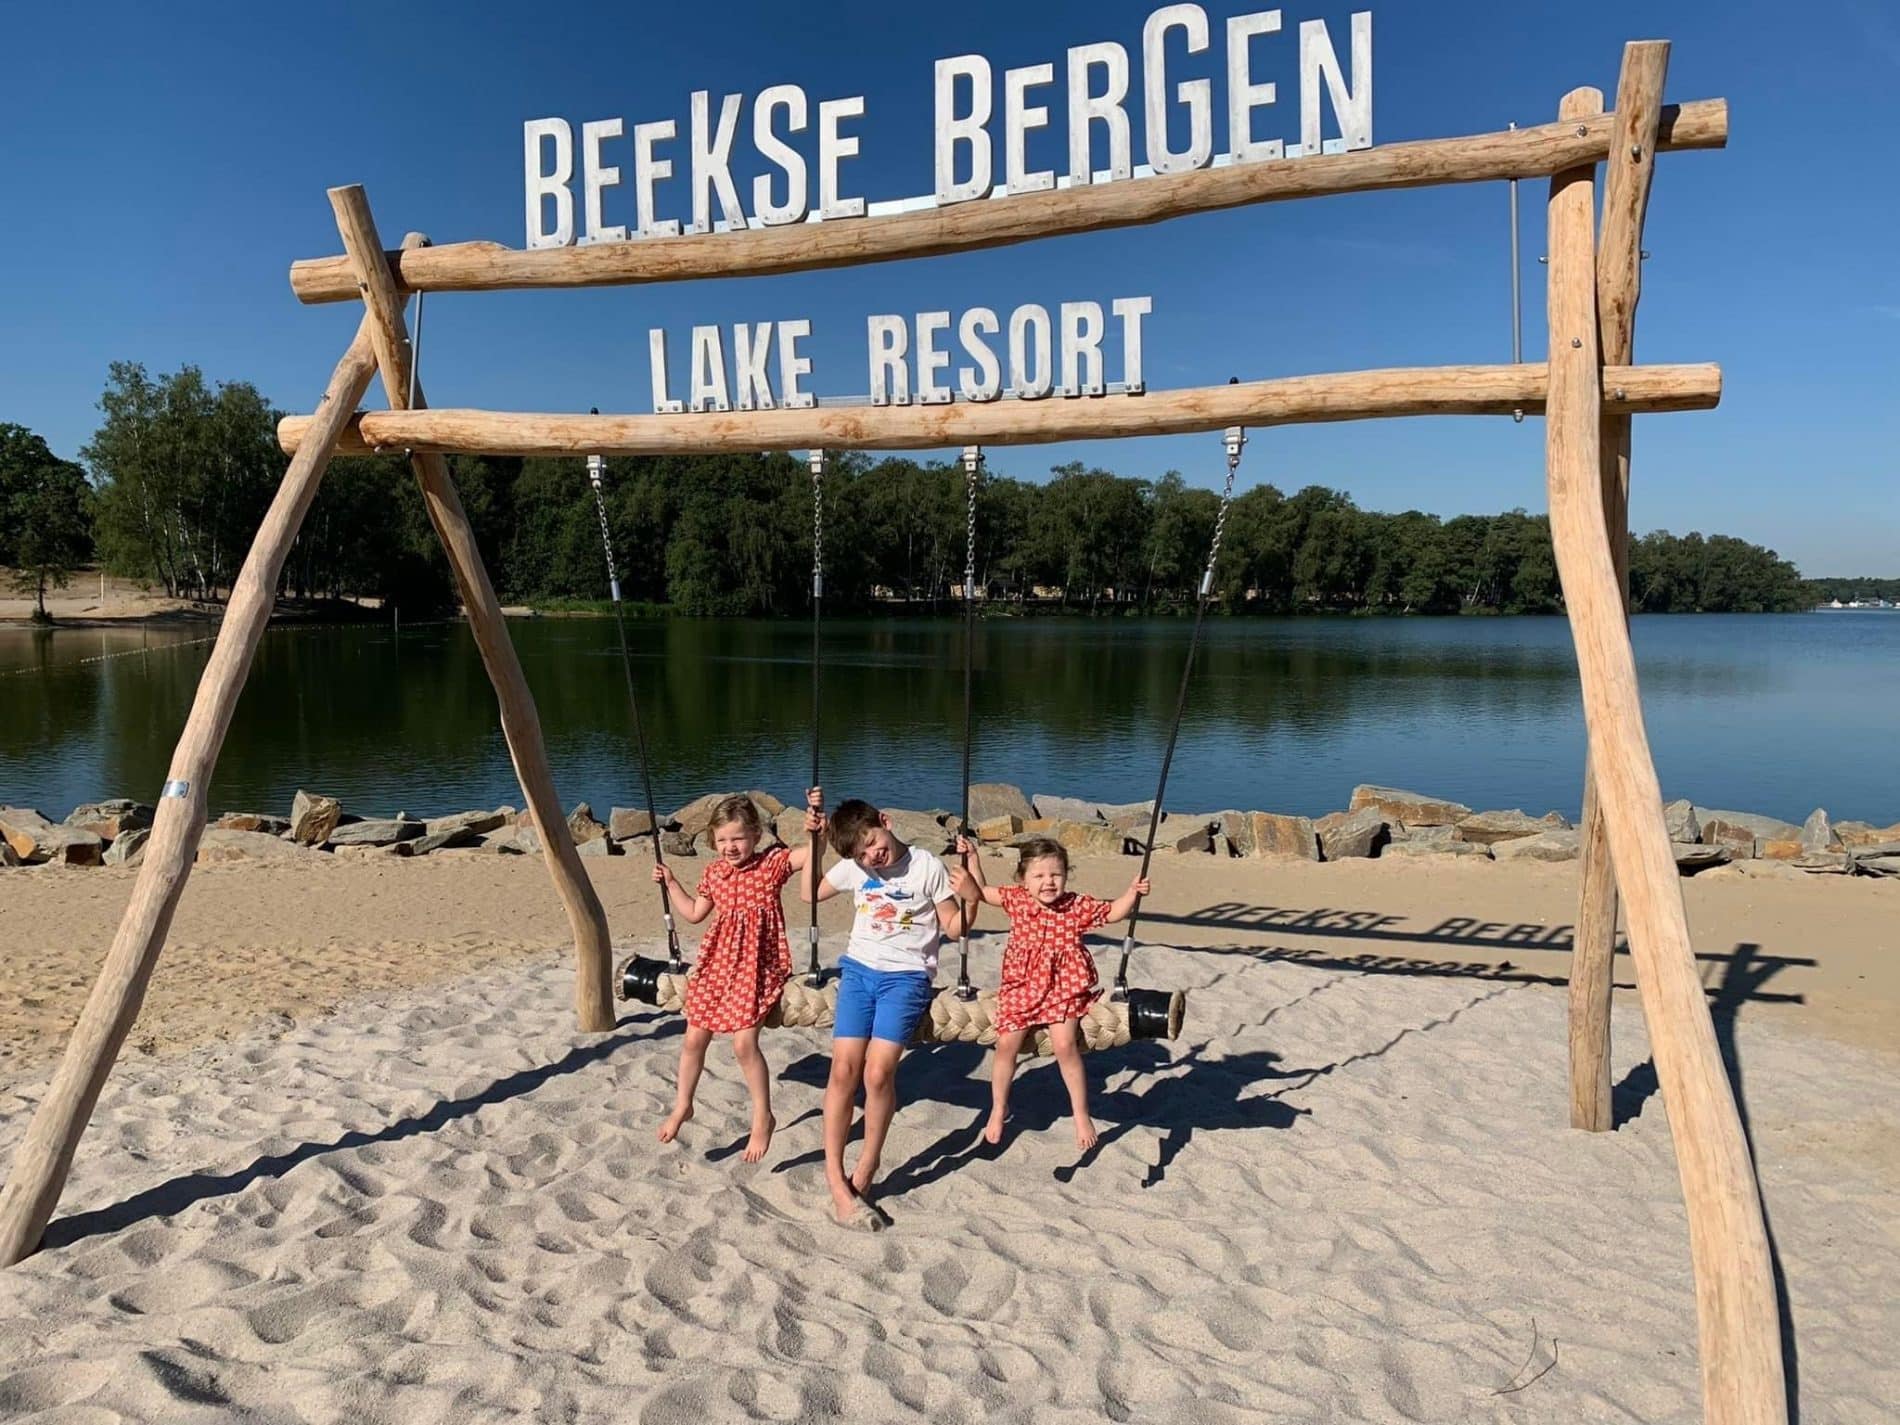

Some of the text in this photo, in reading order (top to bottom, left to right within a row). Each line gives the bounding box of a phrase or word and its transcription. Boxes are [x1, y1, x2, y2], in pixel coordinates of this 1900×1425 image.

[524, 3, 1373, 249] BEEKSE BERGEN
[649, 296, 1153, 414] LAKE RESORT
